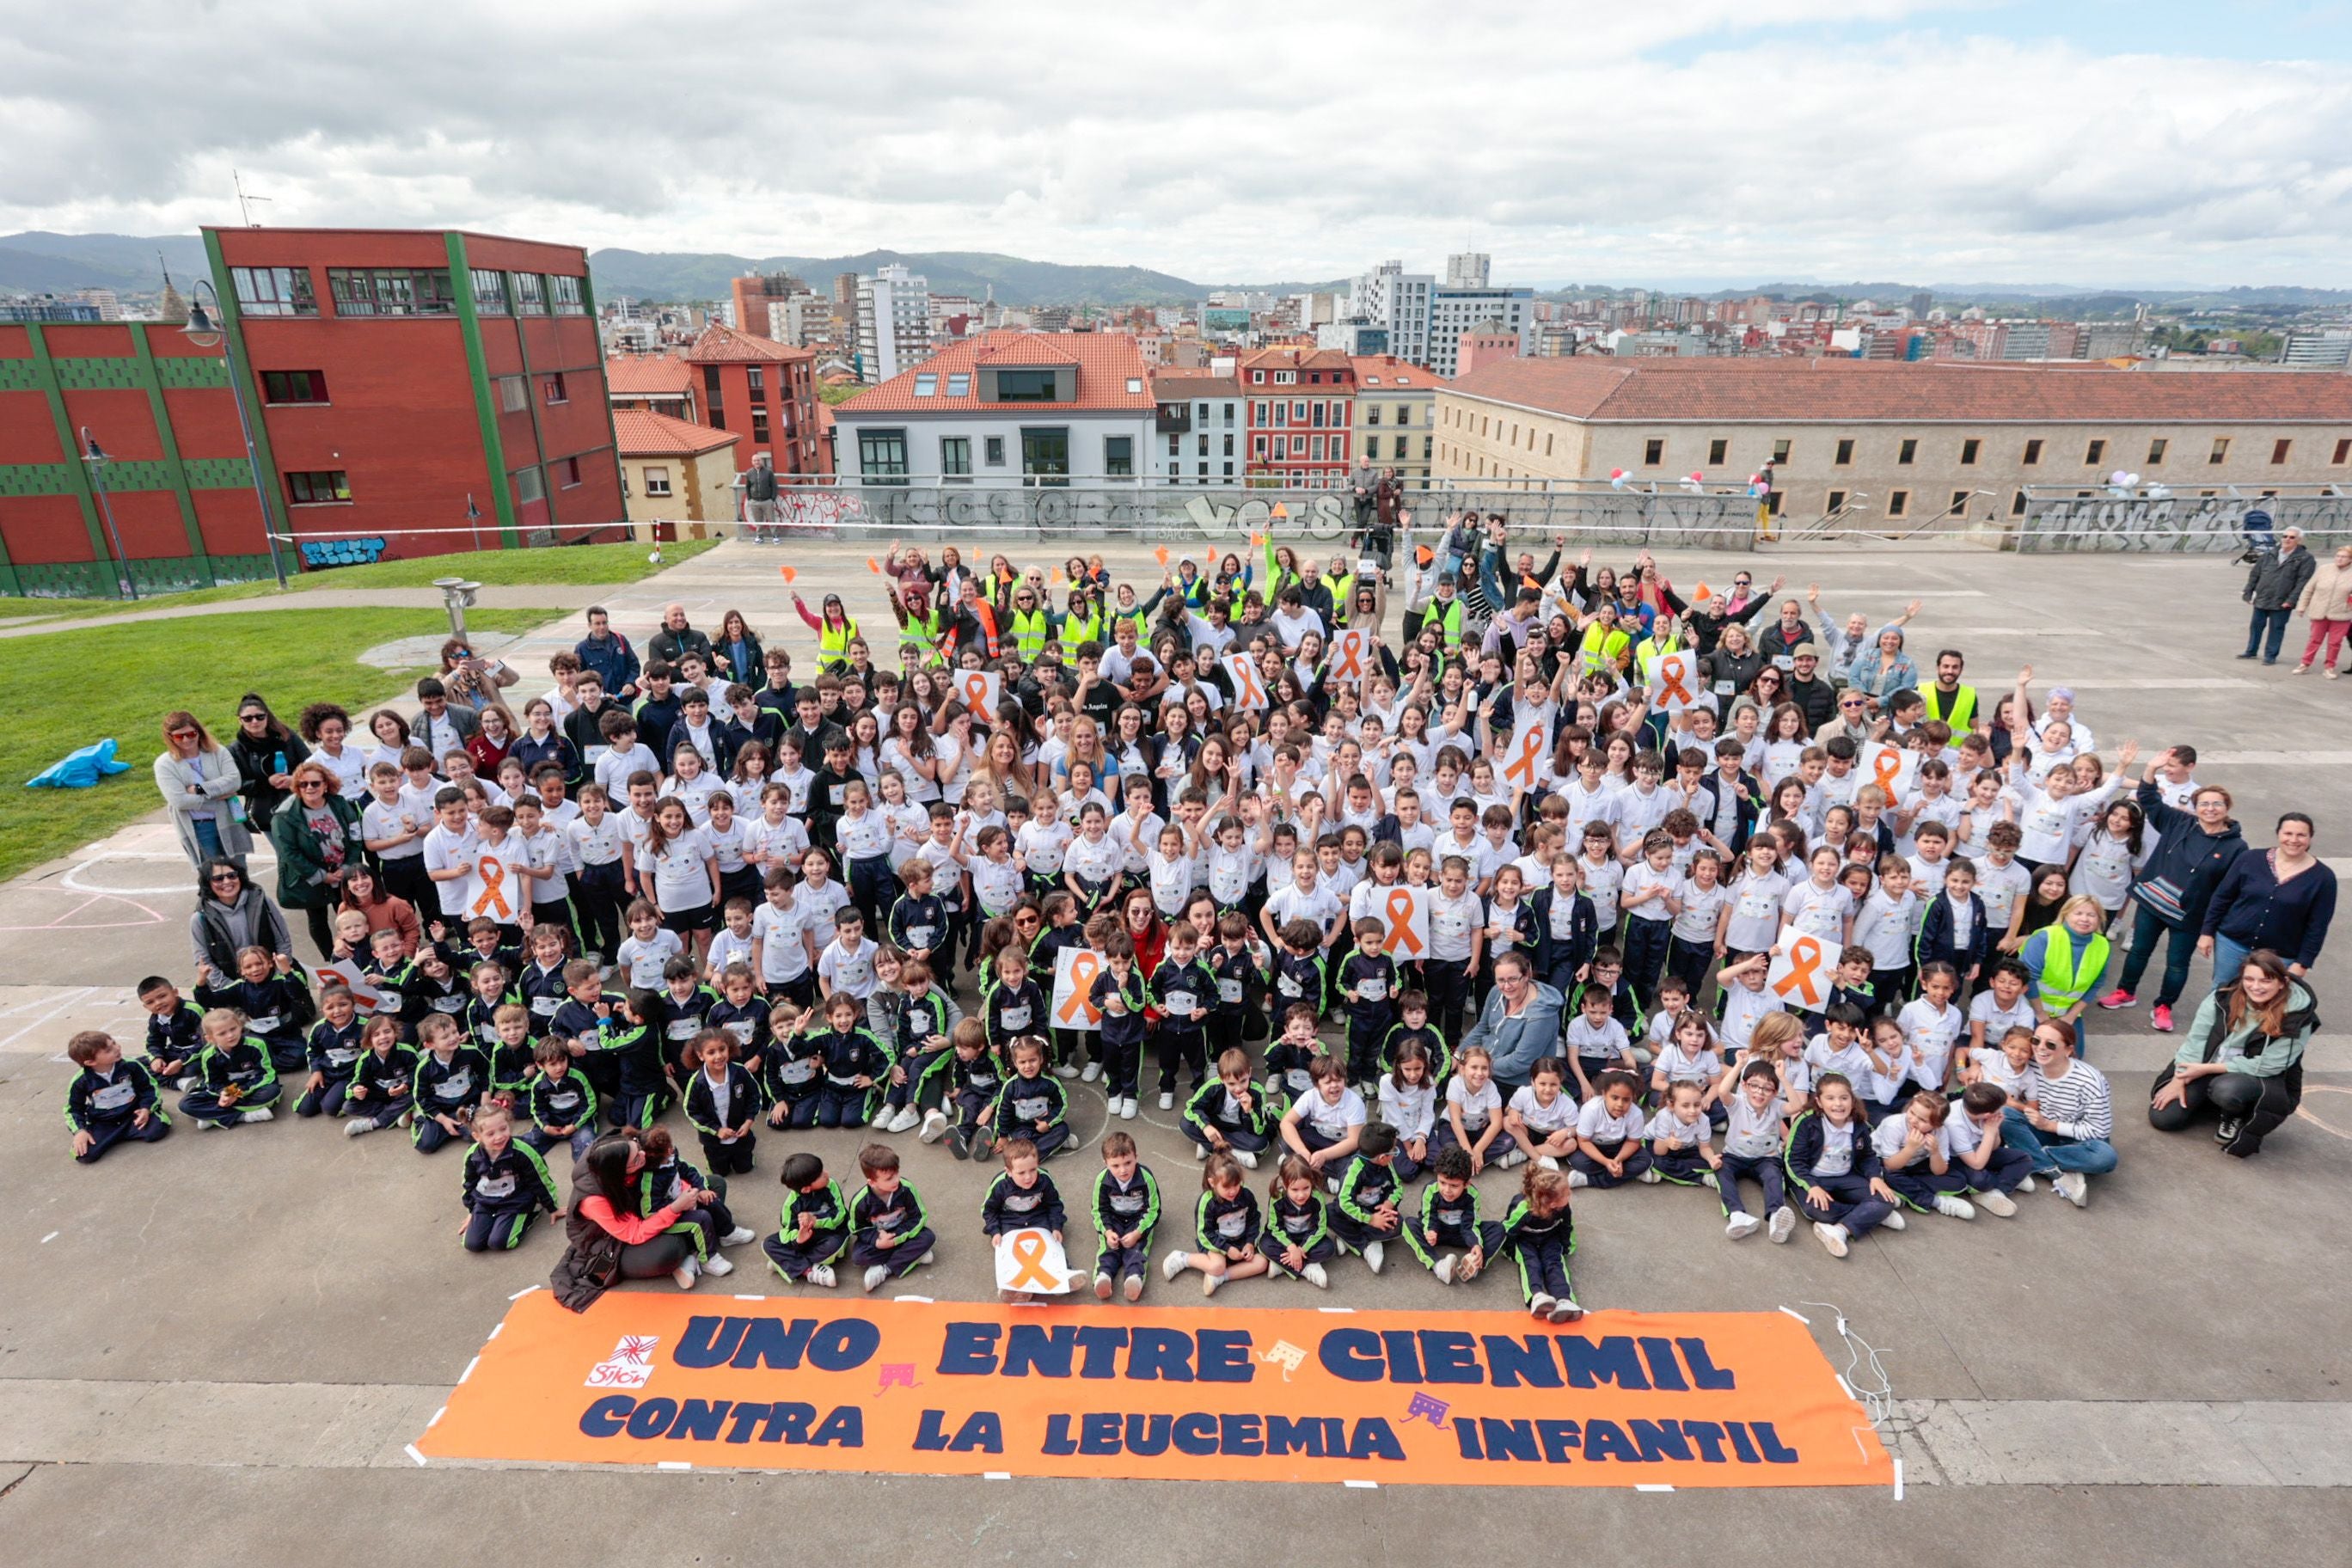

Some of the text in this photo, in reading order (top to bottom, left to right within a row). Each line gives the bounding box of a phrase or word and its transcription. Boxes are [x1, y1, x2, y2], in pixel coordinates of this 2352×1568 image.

[672, 1316, 1736, 1391] UNO ENTRE CIENMIL
[579, 1394, 1800, 1464] CONTRA LA LEUCEMIA INFANTIL
